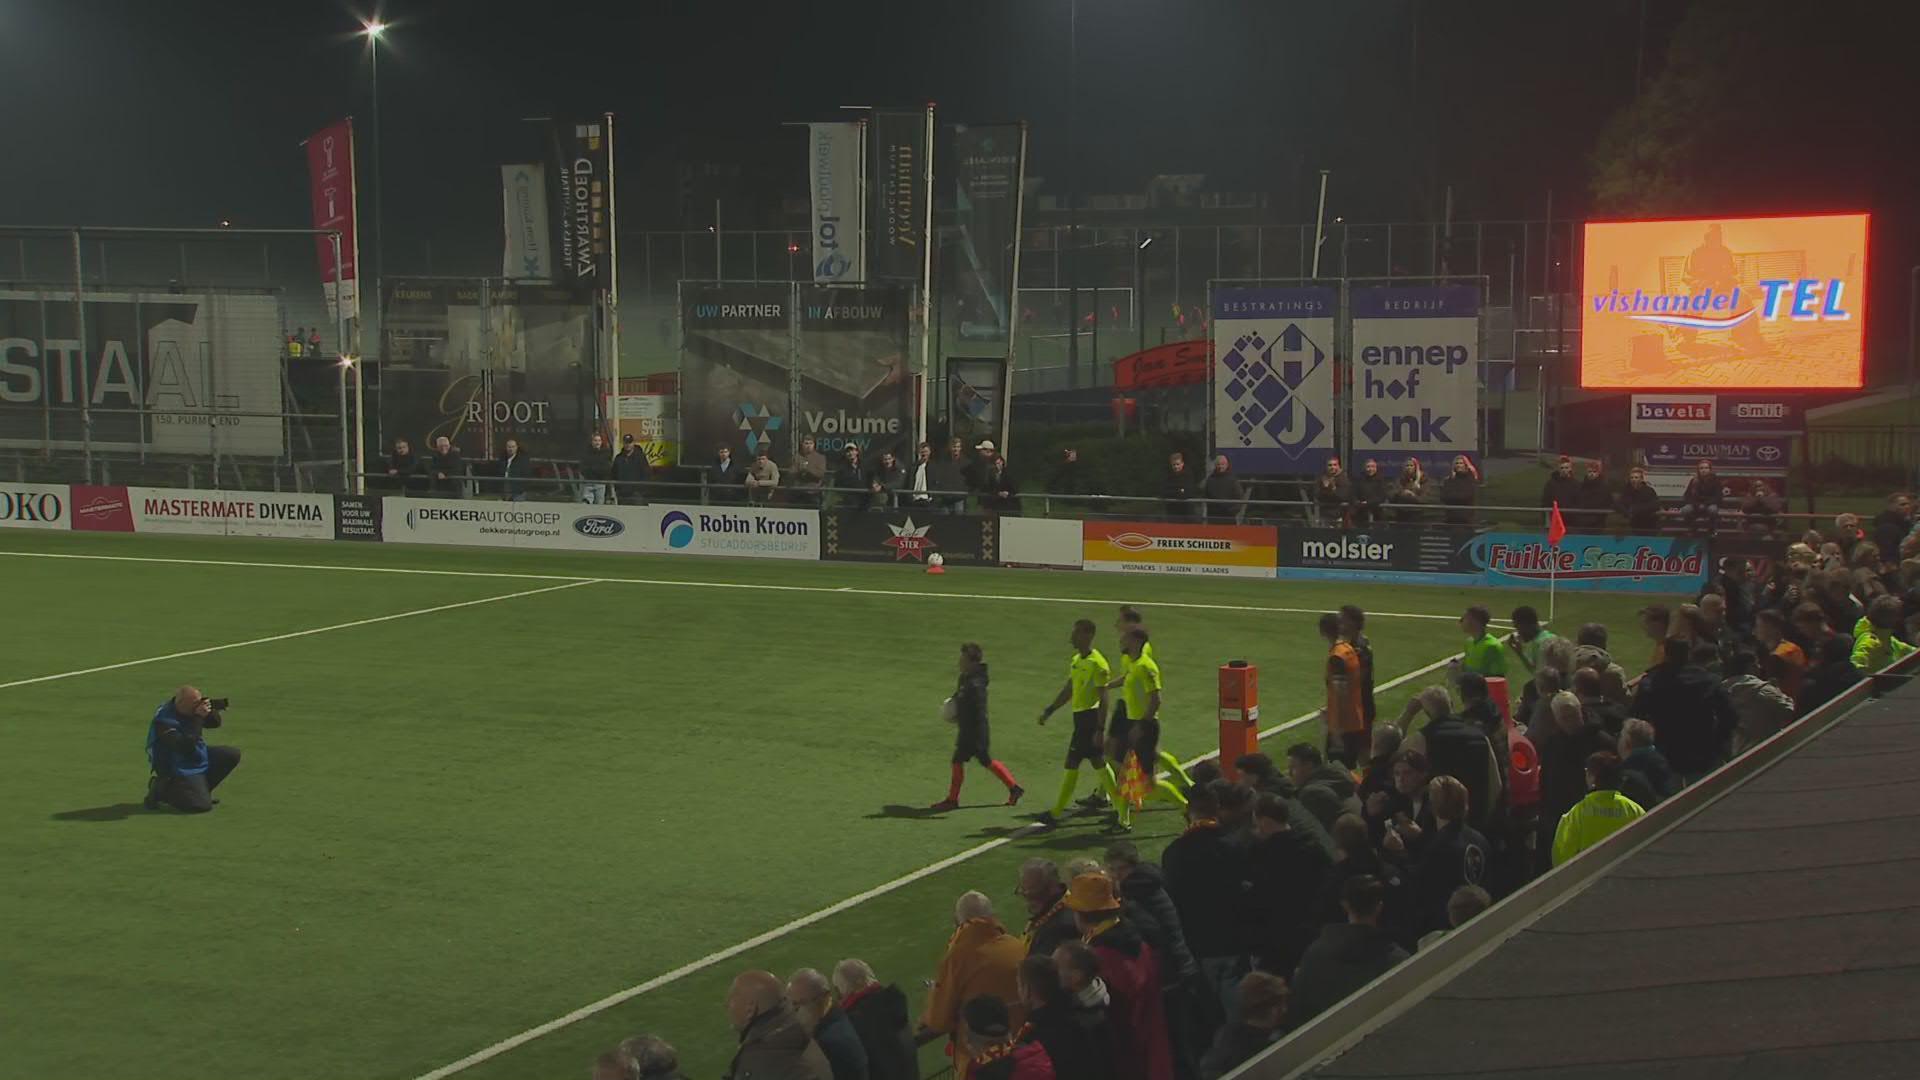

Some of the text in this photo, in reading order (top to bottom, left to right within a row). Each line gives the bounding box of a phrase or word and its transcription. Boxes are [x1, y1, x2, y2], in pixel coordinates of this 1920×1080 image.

[1223, 301, 1324, 312] BESTRATINGS
[1384, 300, 1445, 310] BEDRIJF
[1593, 278, 1852, 321] vishandel TEL
[696, 304, 781, 318] UW PARTNER
[808, 306, 821, 319] IN
[1641, 404, 1705, 418] bevela
[1739, 405, 1782, 416] smit
[804, 409, 900, 434] Volume
[144, 498, 323, 521] MASTERMATE DIVEMA
[419, 508, 560, 525] DEKKERAUTOGROEP
[479, 527, 561, 537] dekkerautogroep.nl
[582, 517, 616, 536] Ford
[699, 514, 808, 536] Robin Kroon
[899, 540, 920, 550] STER
[1157, 539, 1231, 550] FREEK SCHILDER
[1302, 535, 1394, 561] molsier
[1582, 546, 1703, 576] Seafood
